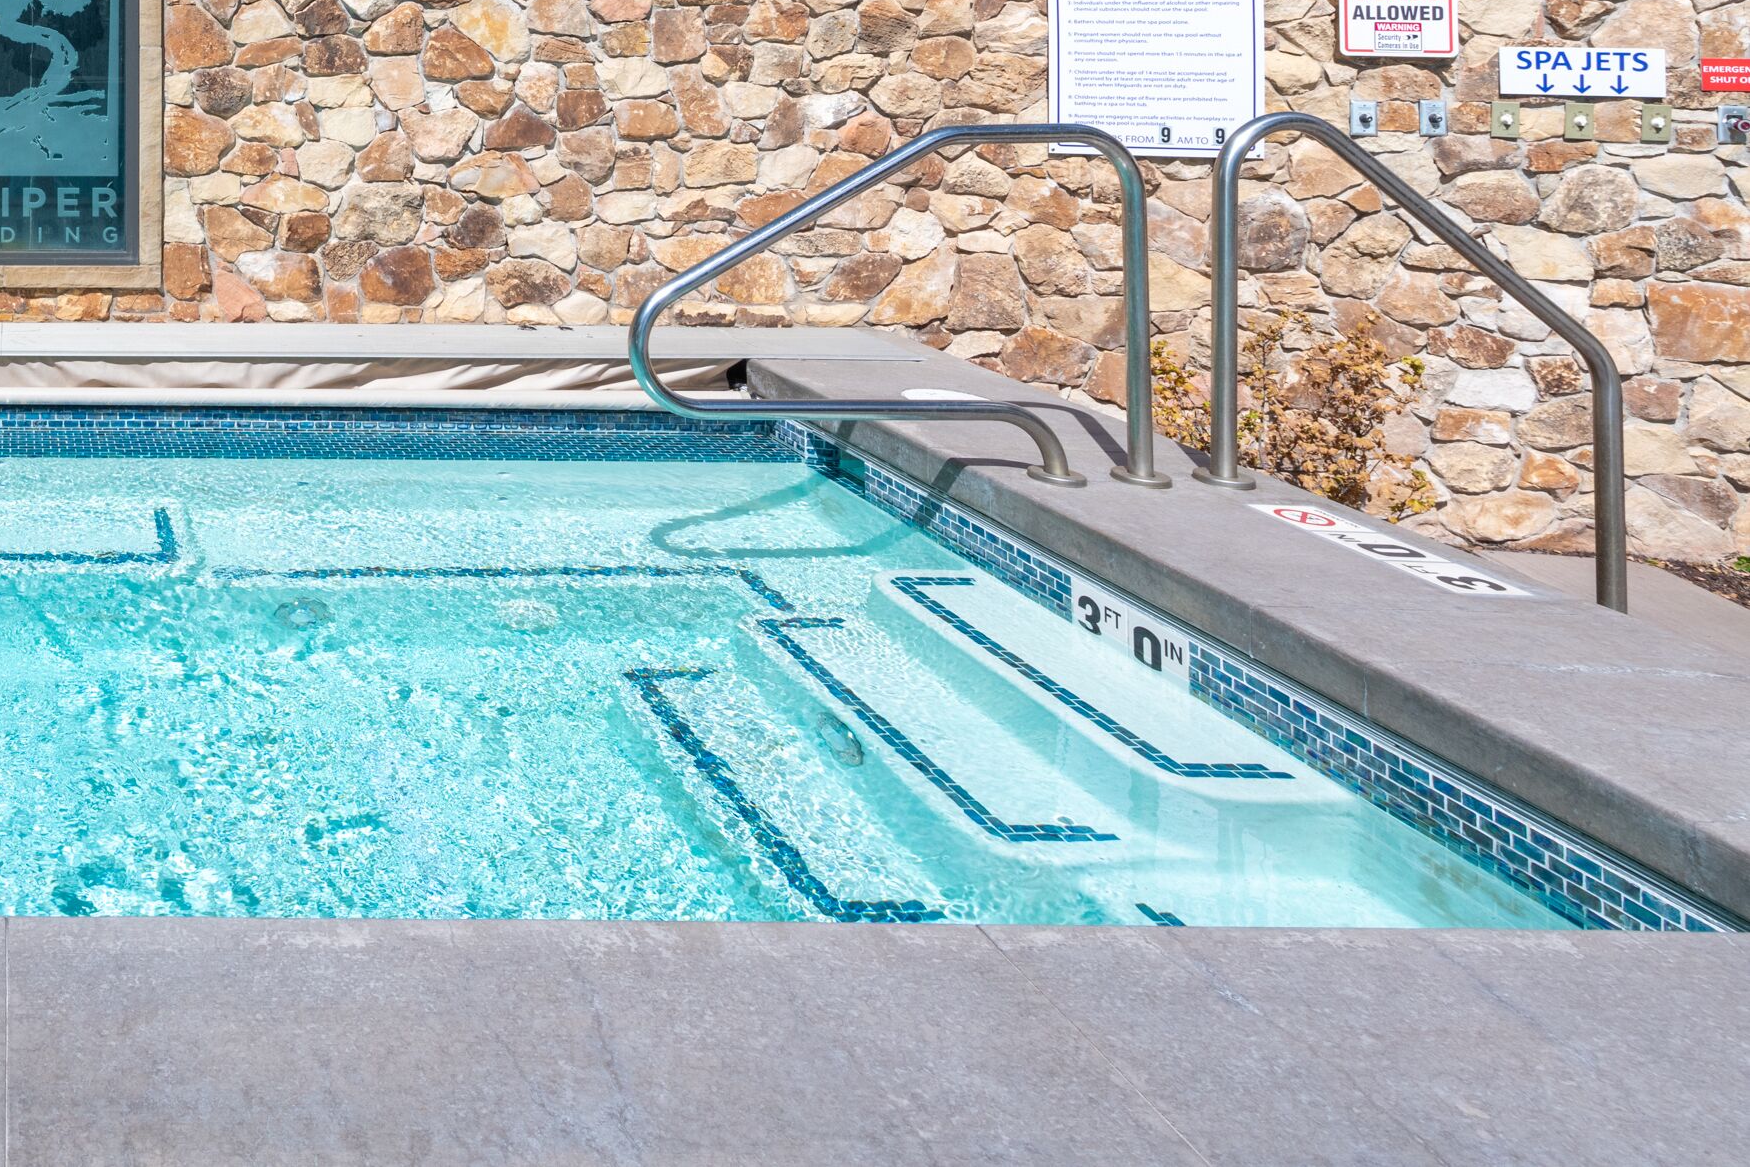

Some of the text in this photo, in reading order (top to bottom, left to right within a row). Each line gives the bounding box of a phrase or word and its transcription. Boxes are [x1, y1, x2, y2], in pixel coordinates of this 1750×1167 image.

[1352, 5, 1444, 21] ALLOWED
[1376, 23, 1420, 31] WARNING
[1516, 50, 1648, 72] SPA JETS
[1710, 76, 1737, 84] SHUT
[1161, 127, 1171, 143] 9
[1215, 128, 1225, 144] 9
[1436, 576, 1507, 591] 3
[1078, 595, 1183, 672] 3 FT 0 IN
